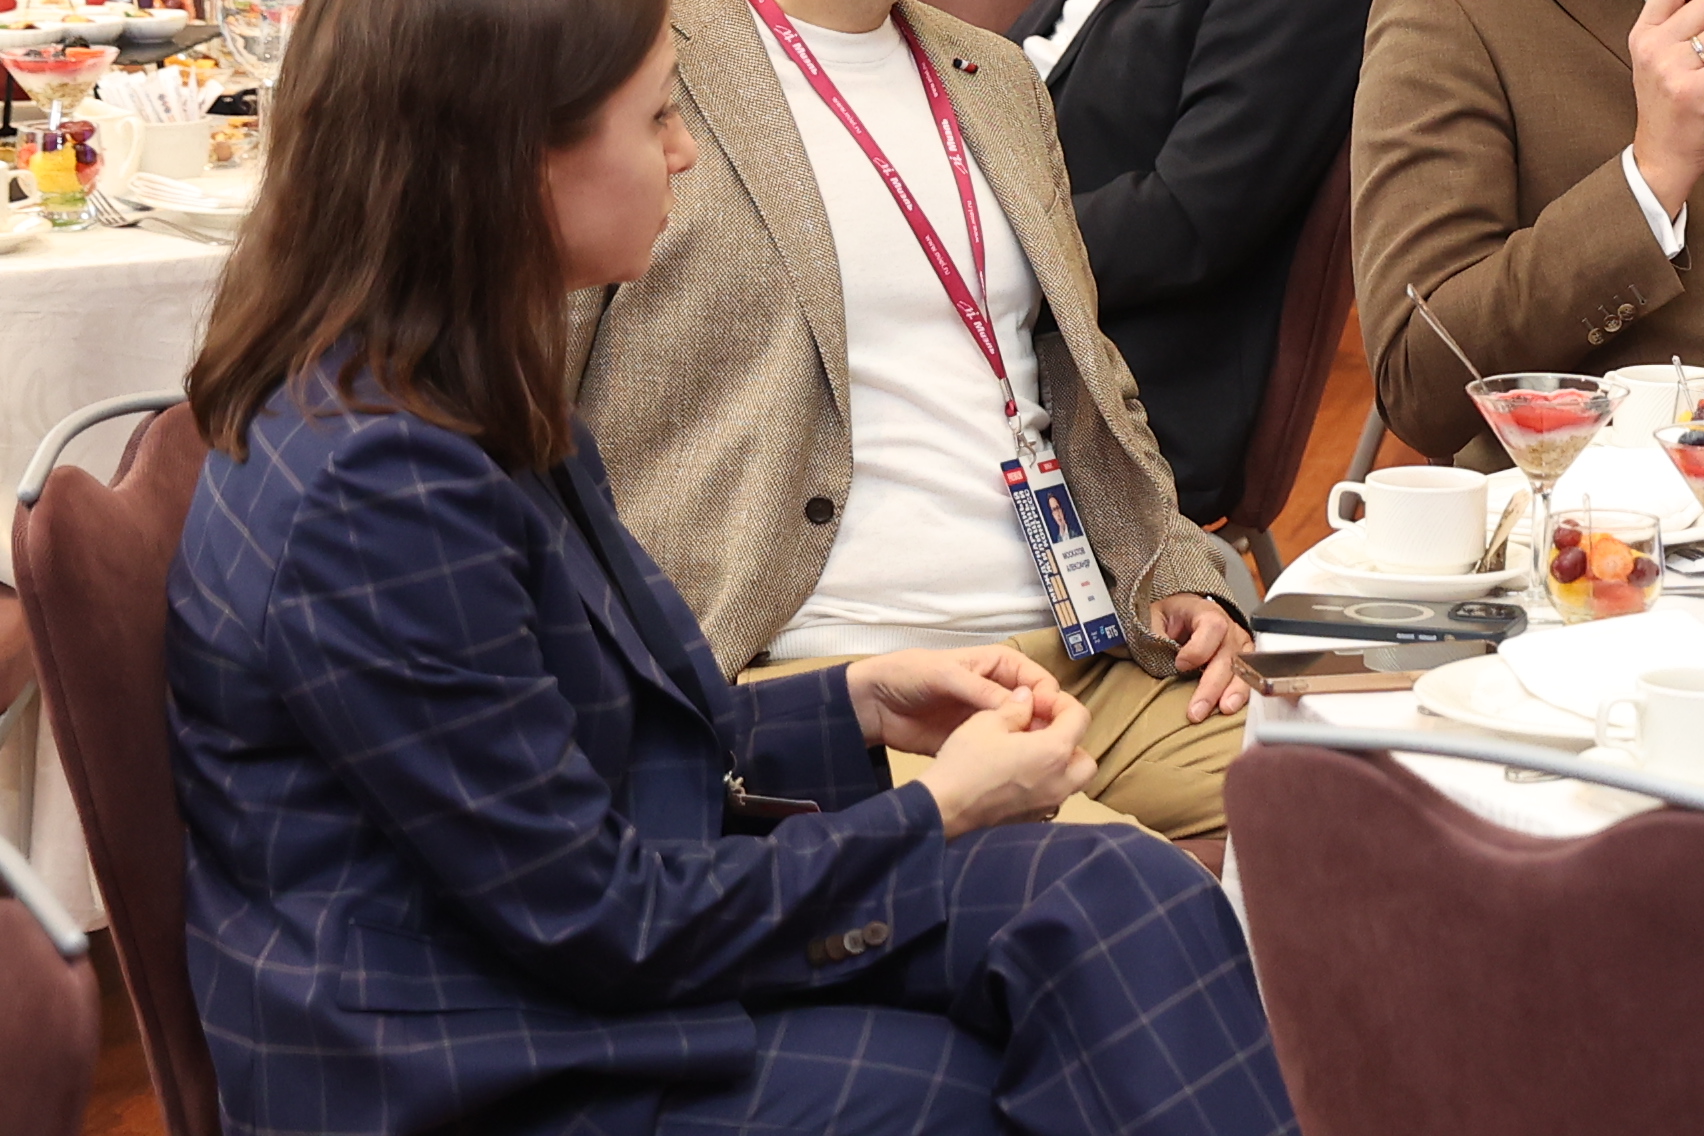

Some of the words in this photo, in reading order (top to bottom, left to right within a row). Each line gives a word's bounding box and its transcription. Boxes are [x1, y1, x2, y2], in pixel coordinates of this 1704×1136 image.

[1013, 490, 1058, 603] МЕЖДУНАРОДНЫЙ
[1019, 489, 1053, 575] ЖИЛИЩНЫЙ
[1024, 488, 1048, 548] КОНГРЕСС
